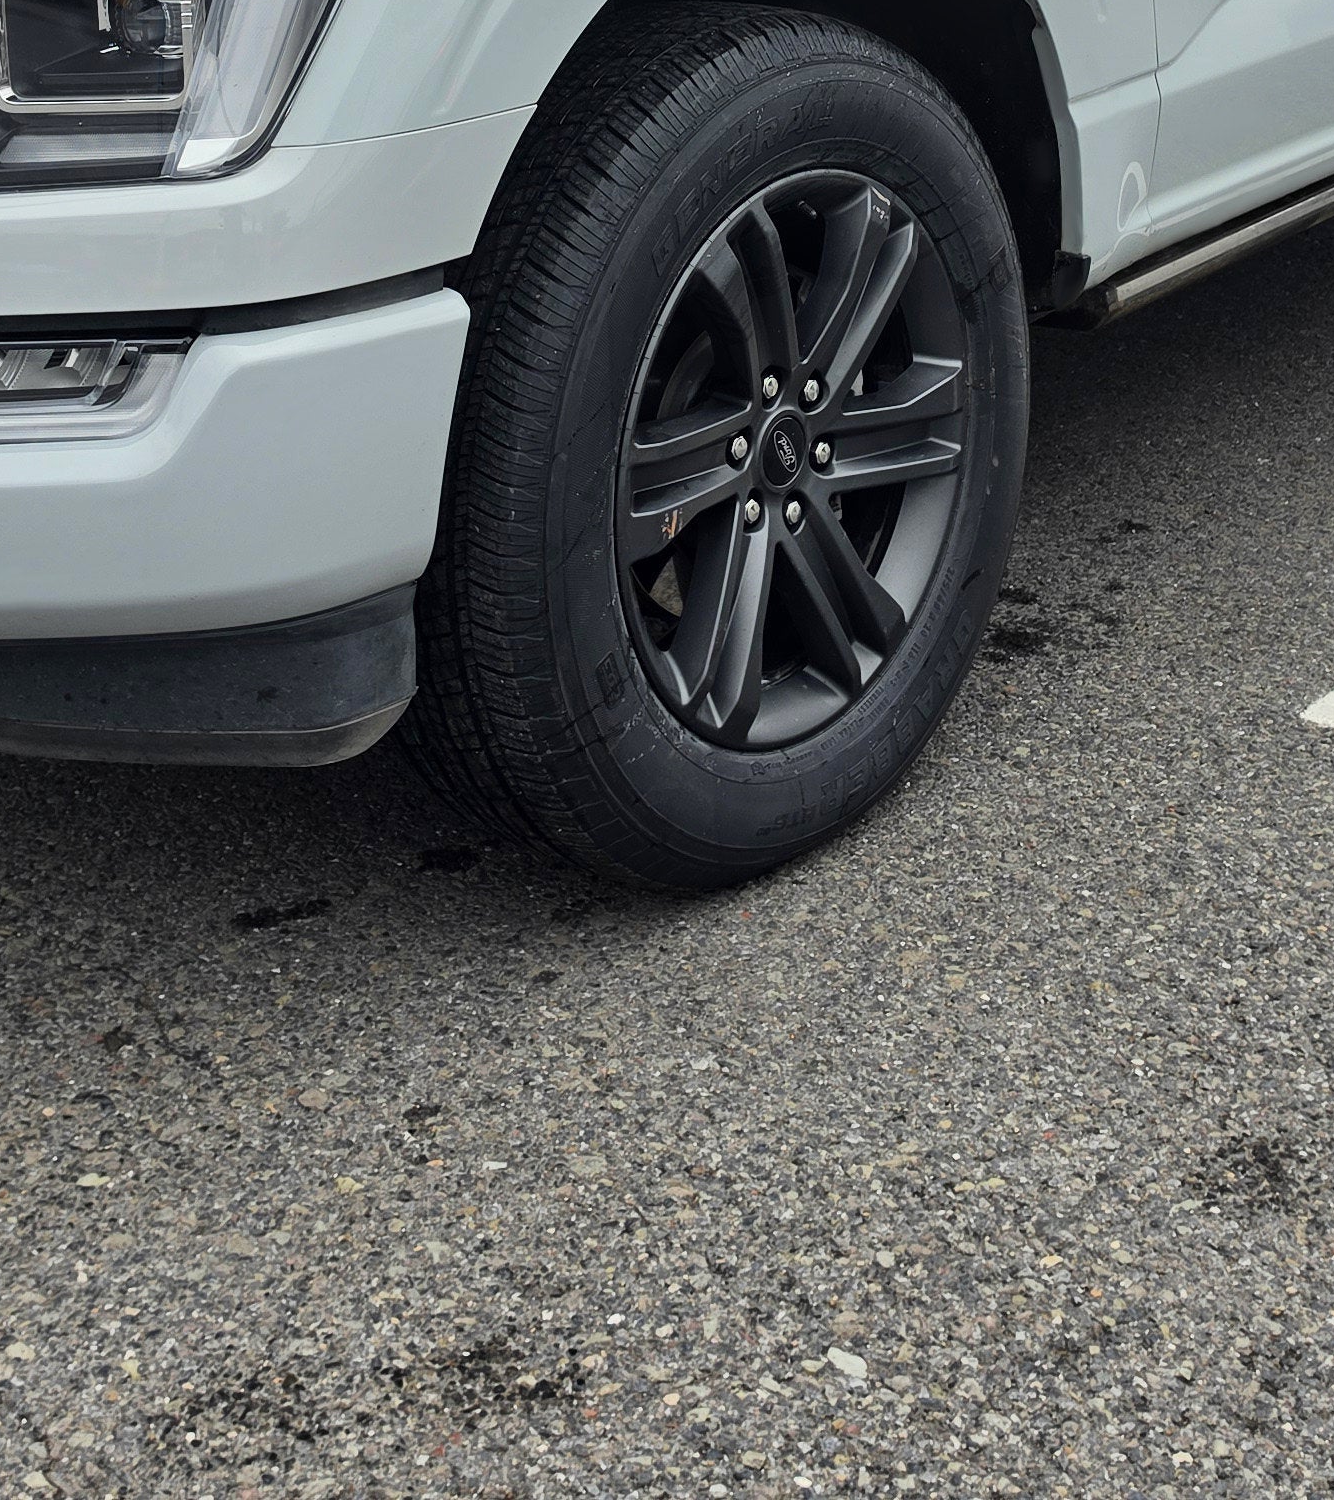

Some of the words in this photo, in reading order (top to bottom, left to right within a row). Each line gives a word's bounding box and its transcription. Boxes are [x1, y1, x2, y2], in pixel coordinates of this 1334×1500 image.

[652, 88, 837, 278] GENERAL
[777, 436, 796, 466] Ford
[820, 608, 975, 816] GRABBER
